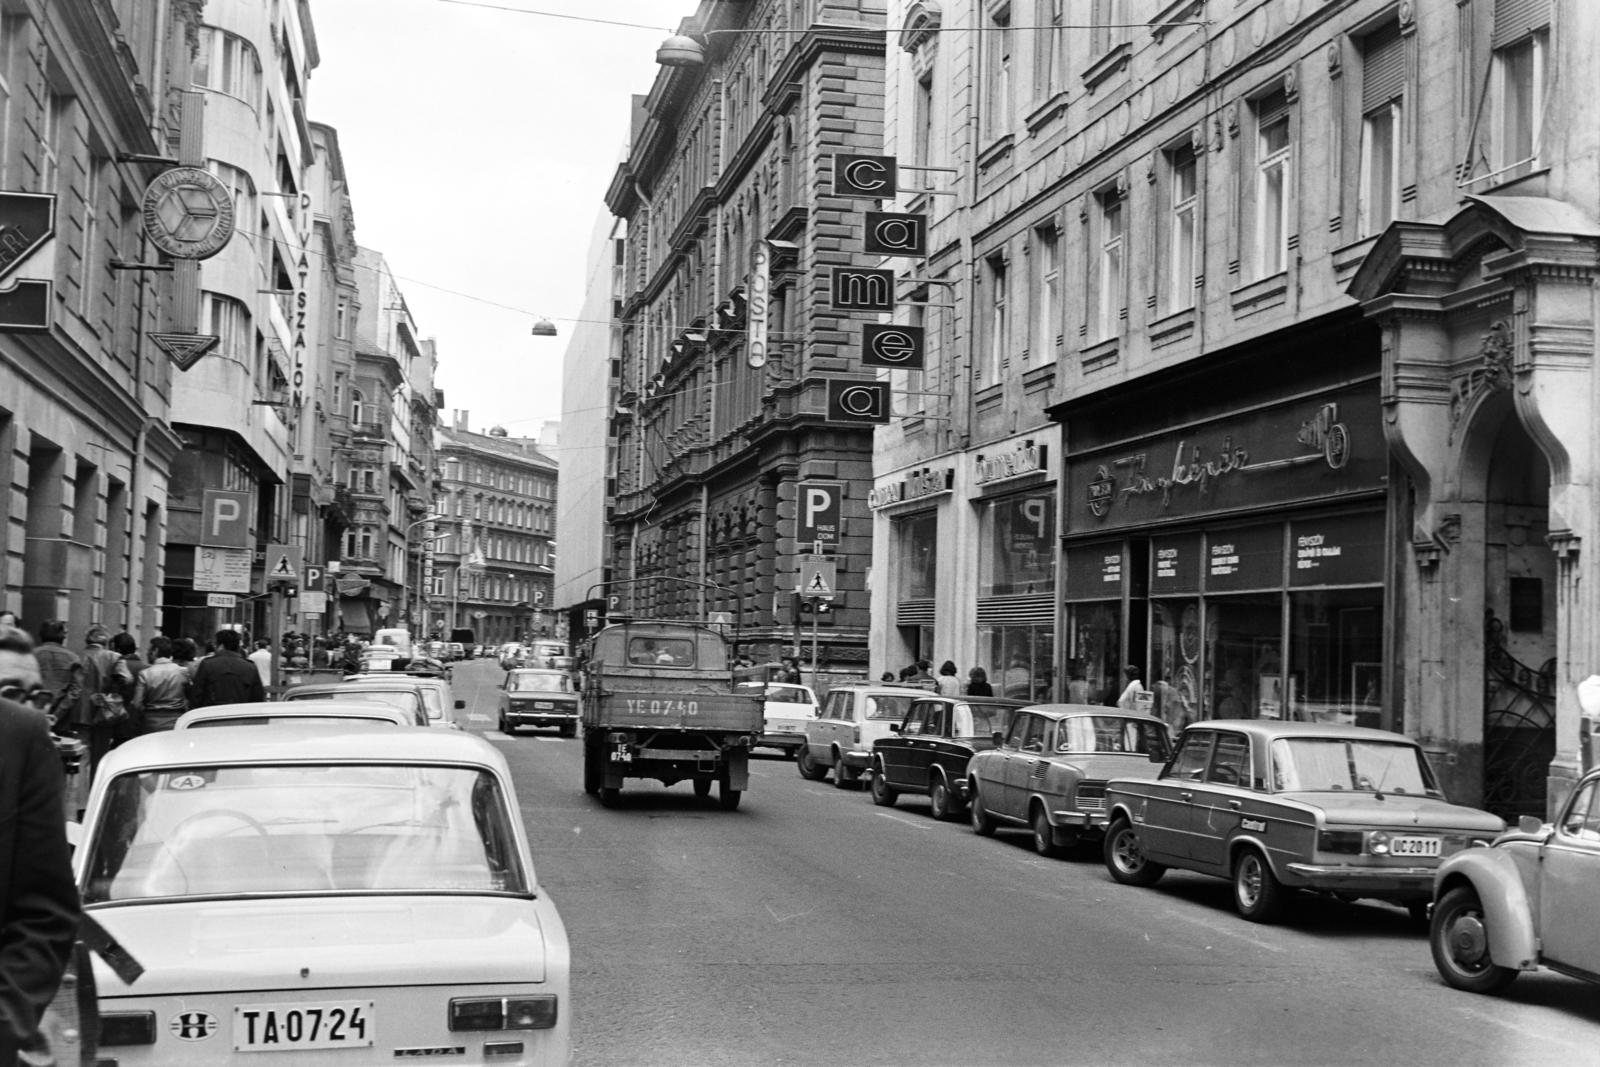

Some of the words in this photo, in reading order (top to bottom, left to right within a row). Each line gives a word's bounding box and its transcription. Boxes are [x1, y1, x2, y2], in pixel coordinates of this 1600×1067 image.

[293, 193, 311, 407] DIVATSZALON
[750, 252, 766, 360] POSTA
[212, 498, 240, 536] P
[805, 488, 832, 528] P
[307, 568, 320, 587] P
[534, 591, 543, 604] P
[610, 596, 619, 609] P
[626, 699, 646, 714] YE
[651, 700, 698, 716] 07-40
[179, 777, 194, 788] A
